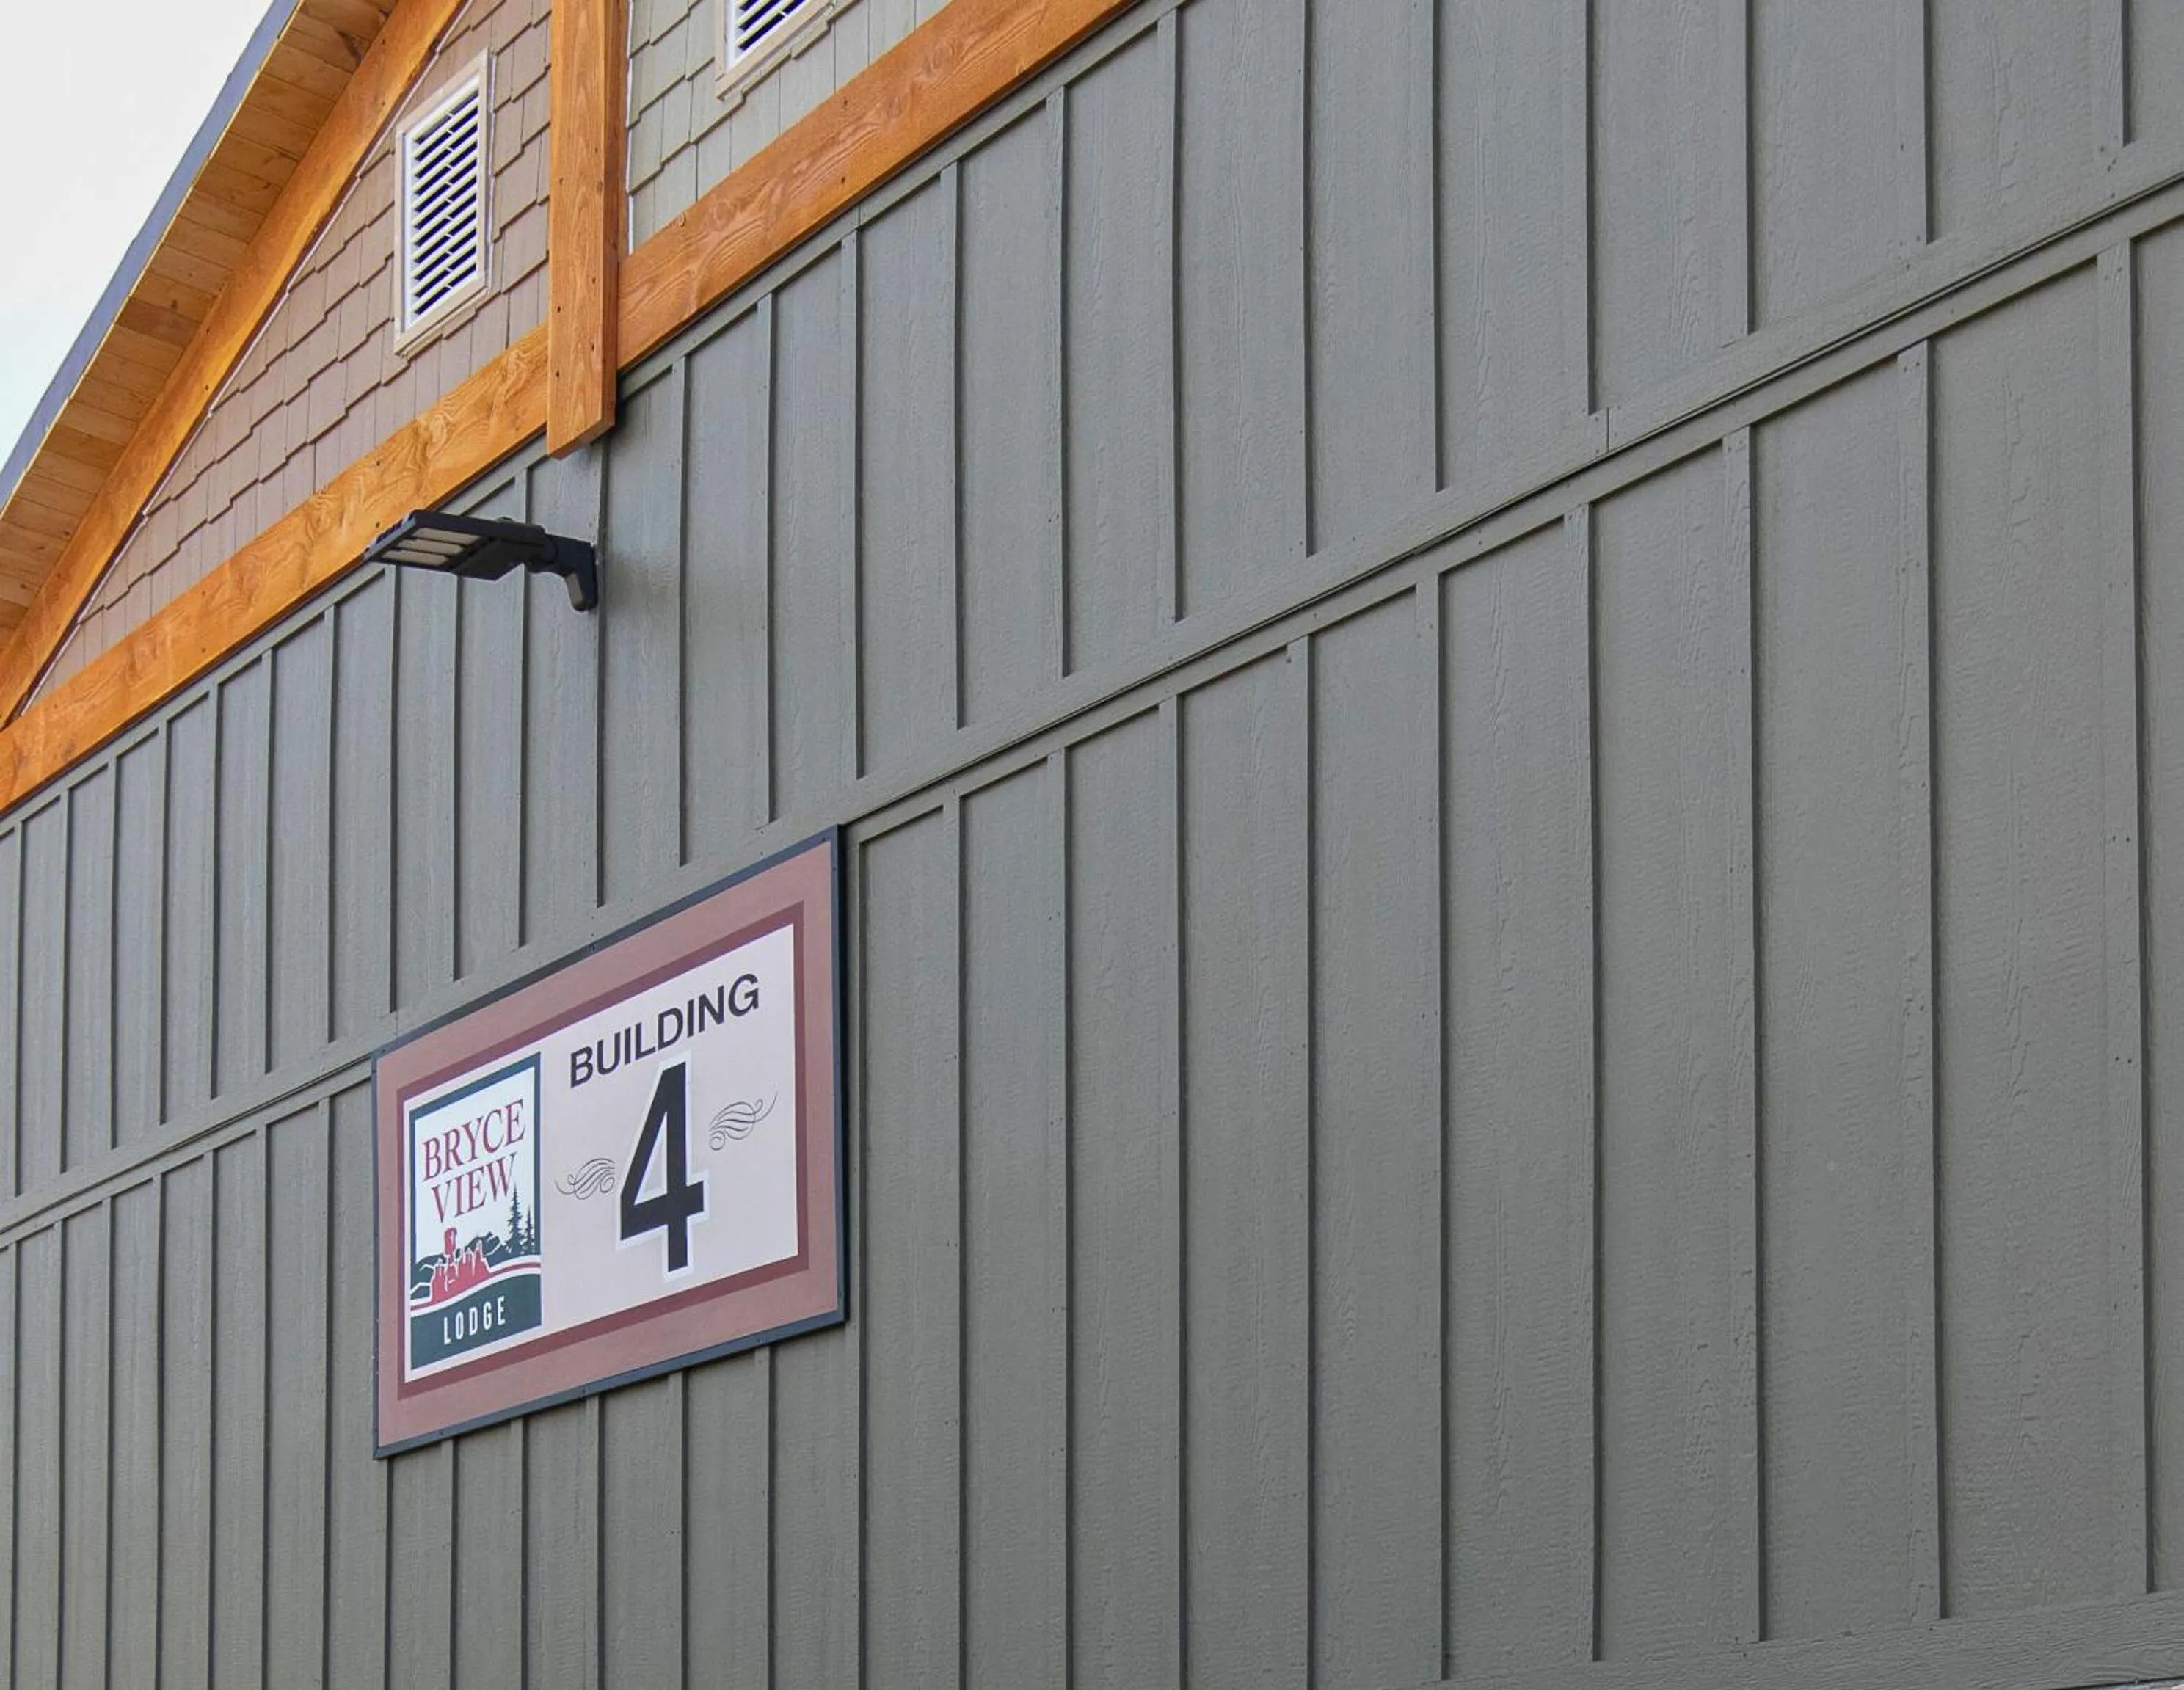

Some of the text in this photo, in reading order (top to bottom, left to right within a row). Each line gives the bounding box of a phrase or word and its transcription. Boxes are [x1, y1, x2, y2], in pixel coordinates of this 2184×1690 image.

[570, 973, 760, 1088] BUILDING
[422, 1099, 526, 1182] BRYCE
[620, 1061, 704, 1272] 4
[431, 1152, 517, 1223] VIEW
[443, 1295, 506, 1344] LODGE
